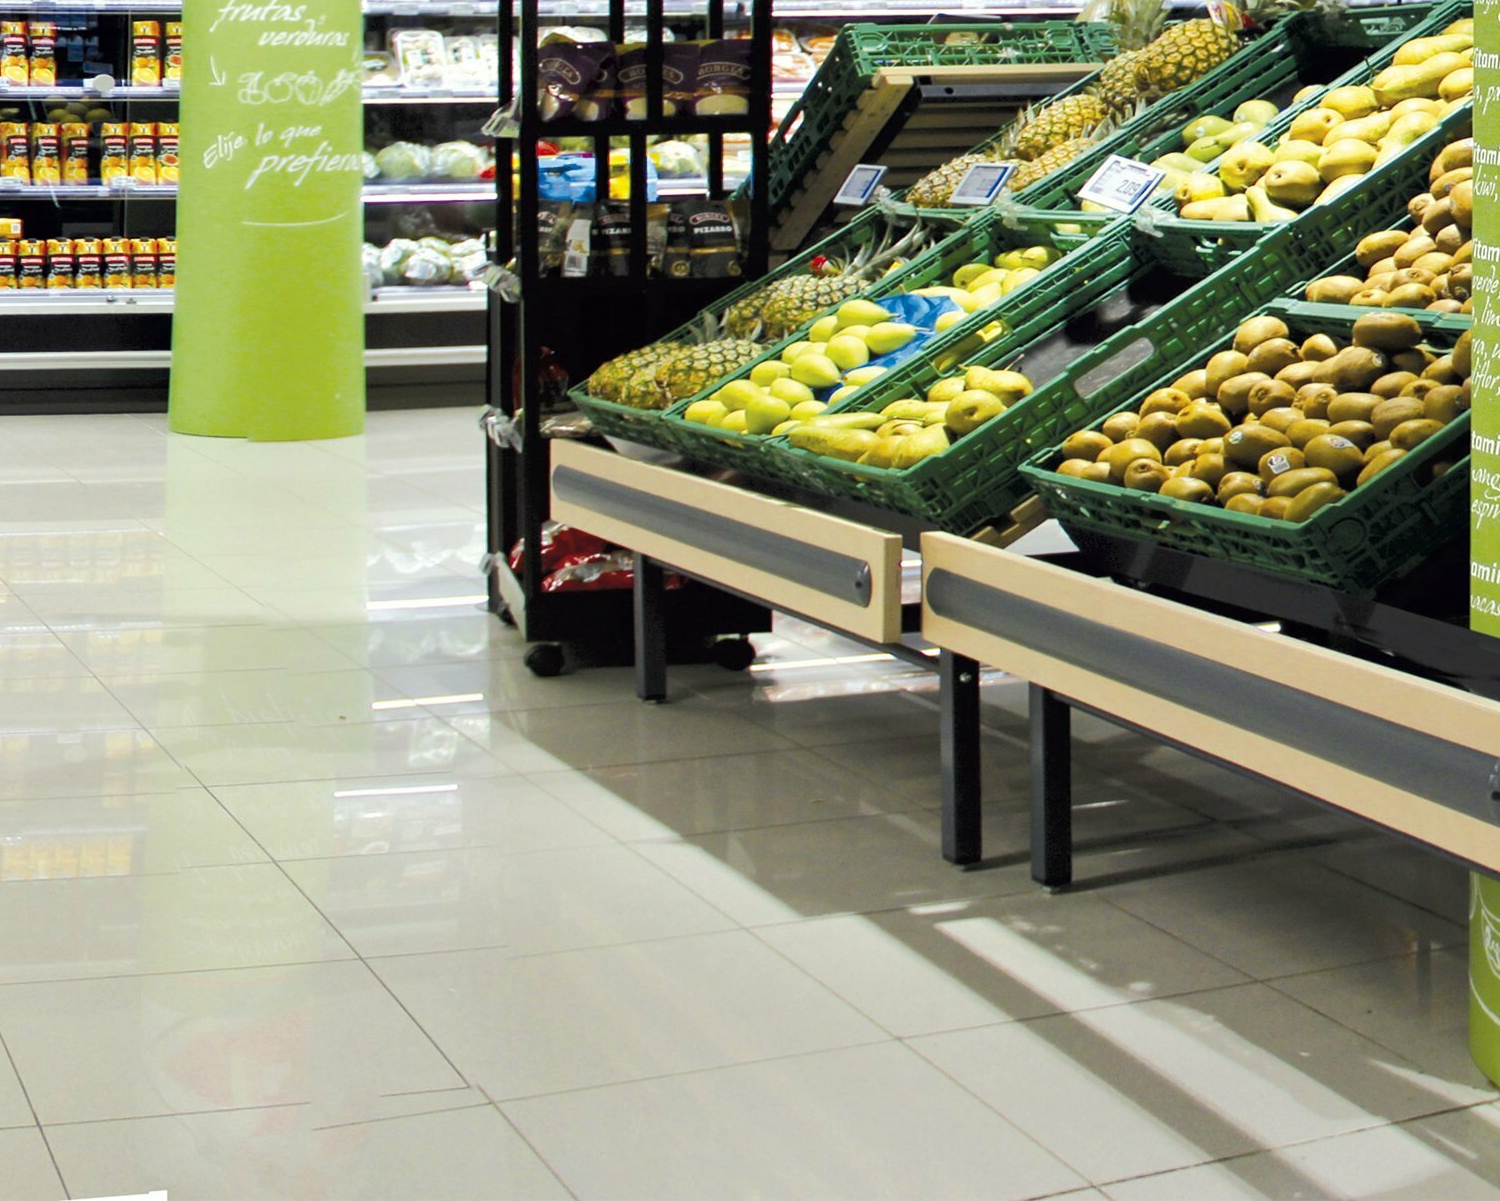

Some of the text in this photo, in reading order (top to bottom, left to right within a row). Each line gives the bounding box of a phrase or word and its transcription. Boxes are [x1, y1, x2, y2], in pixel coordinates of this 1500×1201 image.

[257, 18, 348, 47] verduras
[255, 122, 271, 145] lo
[278, 125, 323, 148] que
